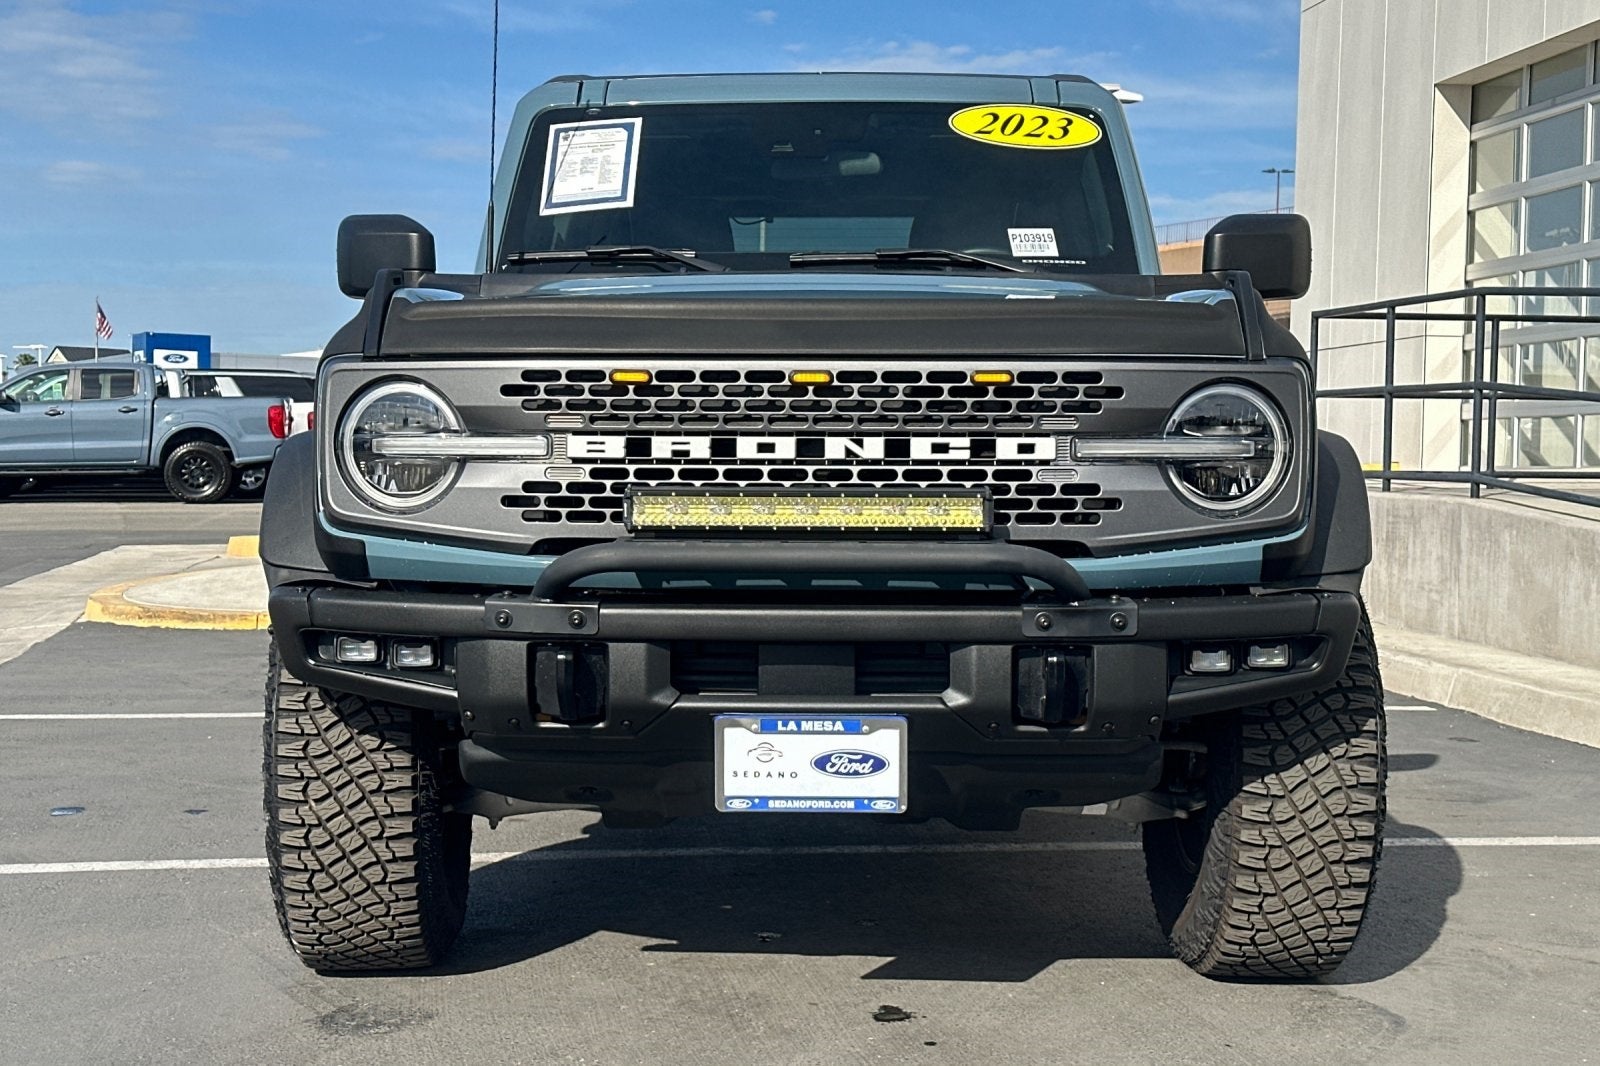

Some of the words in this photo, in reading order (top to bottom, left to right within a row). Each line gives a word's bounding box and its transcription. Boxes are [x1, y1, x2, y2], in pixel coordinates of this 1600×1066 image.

[974, 112, 1074, 140] 2023
[1011, 233, 1054, 243] P103919
[566, 435, 1056, 459] BRONCO
[777, 720, 798, 731] LA
[800, 720, 844, 731] MESA
[825, 753, 873, 774] Ford
[732, 770, 798, 779] SEDANO
[768, 799, 855, 809] SEDANOFORD.COM
